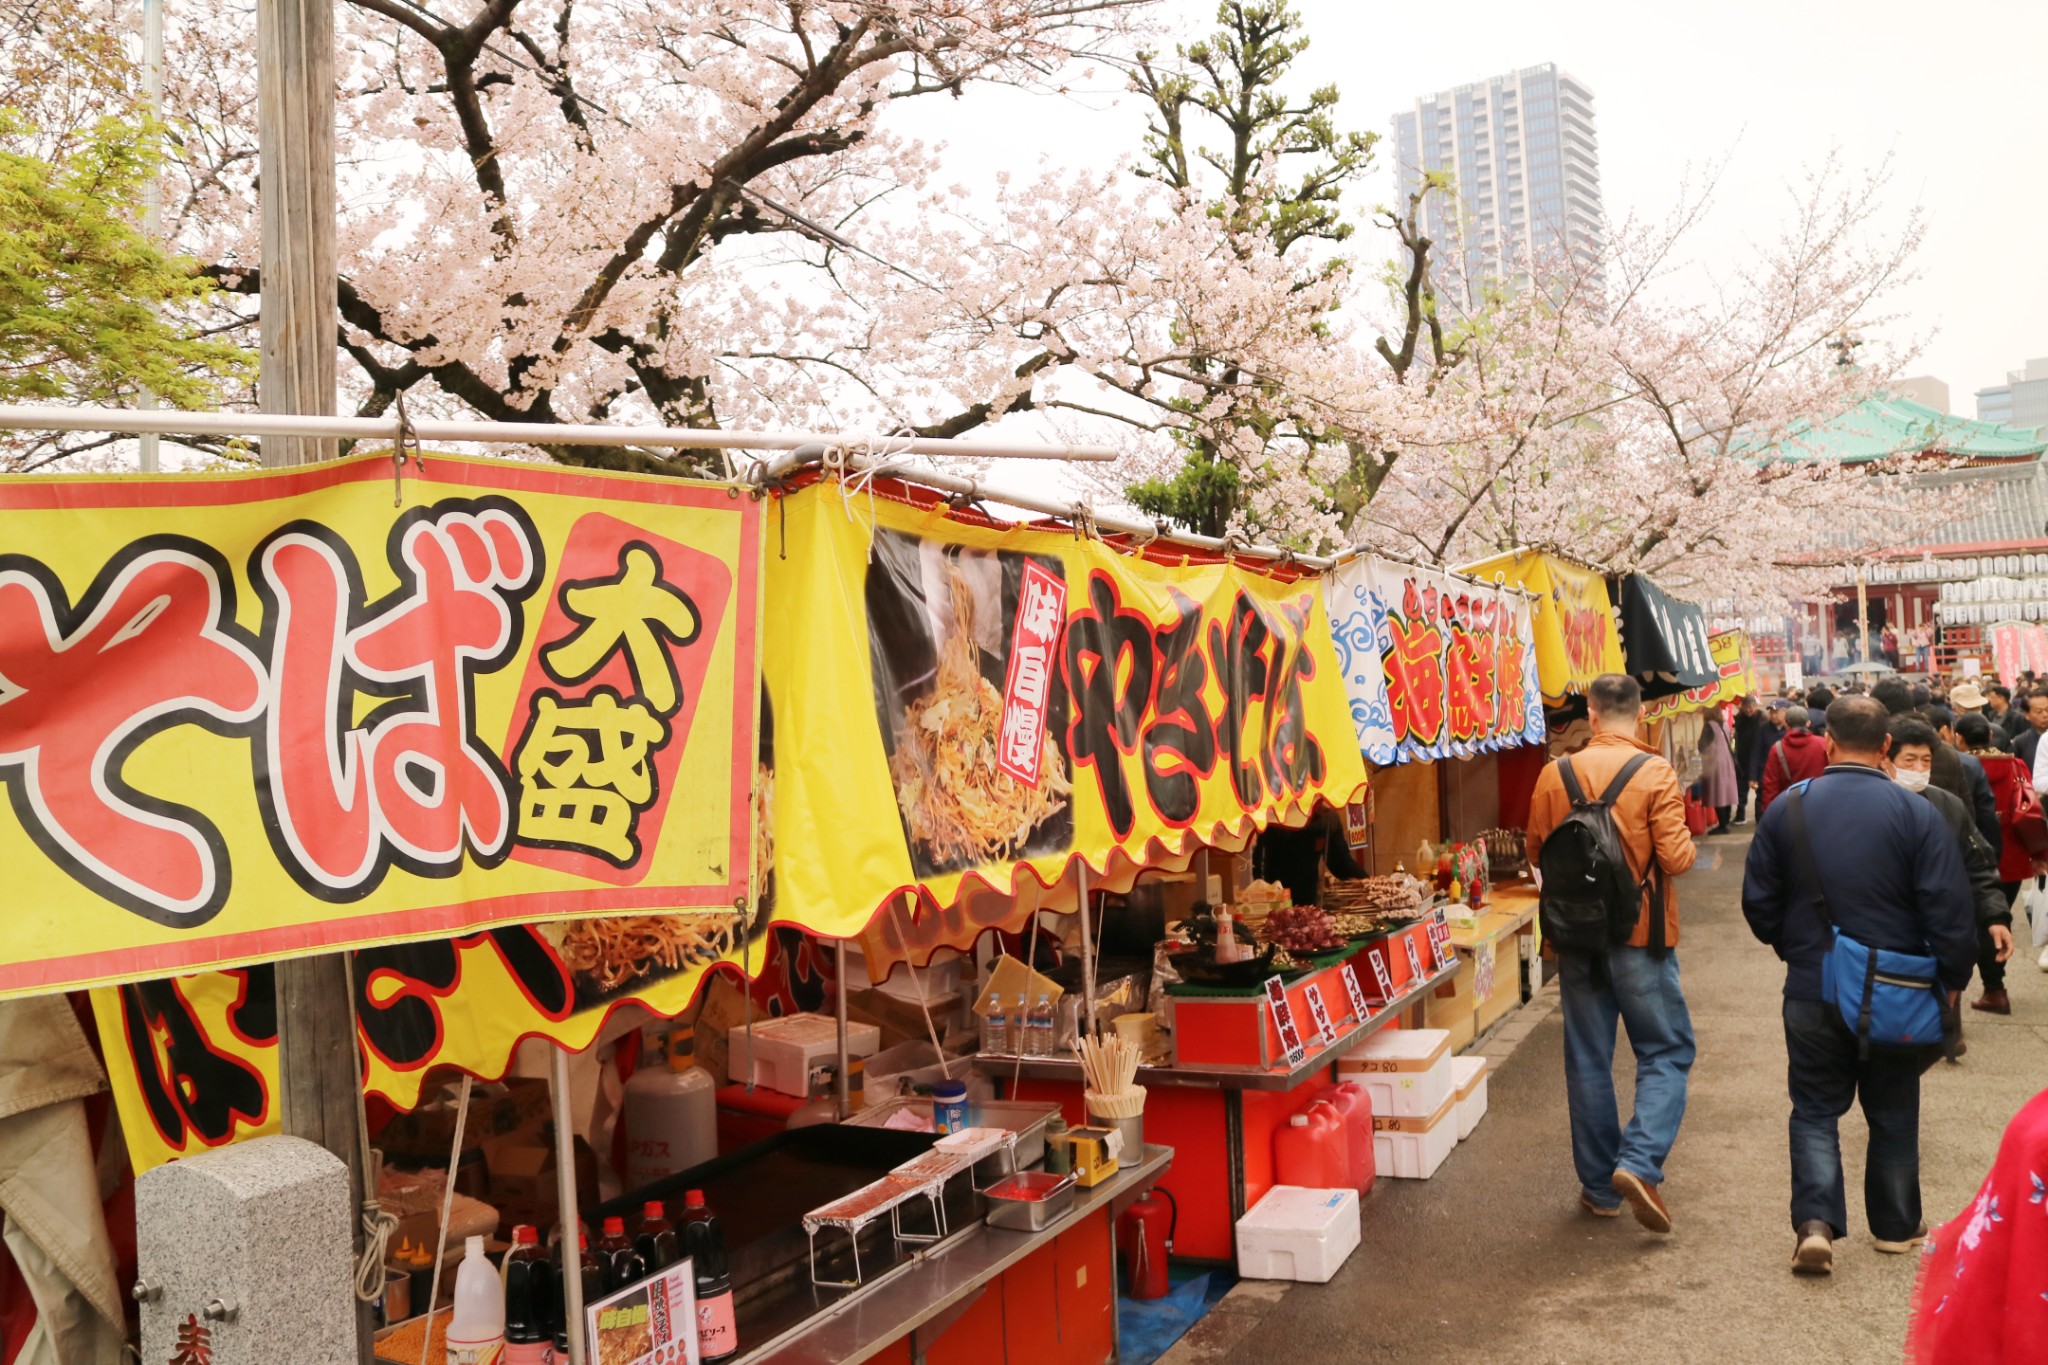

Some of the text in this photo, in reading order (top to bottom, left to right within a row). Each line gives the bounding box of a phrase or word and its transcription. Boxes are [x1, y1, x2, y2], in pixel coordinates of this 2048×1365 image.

[513, 540, 700, 869] 大盛
[1003, 576, 1060, 774] 味自慢
[1381, 612, 1526, 747] 海鮮焼
[1267, 979, 1299, 1051] 海鮮焼
[1308, 987, 1334, 1042] サザエ
